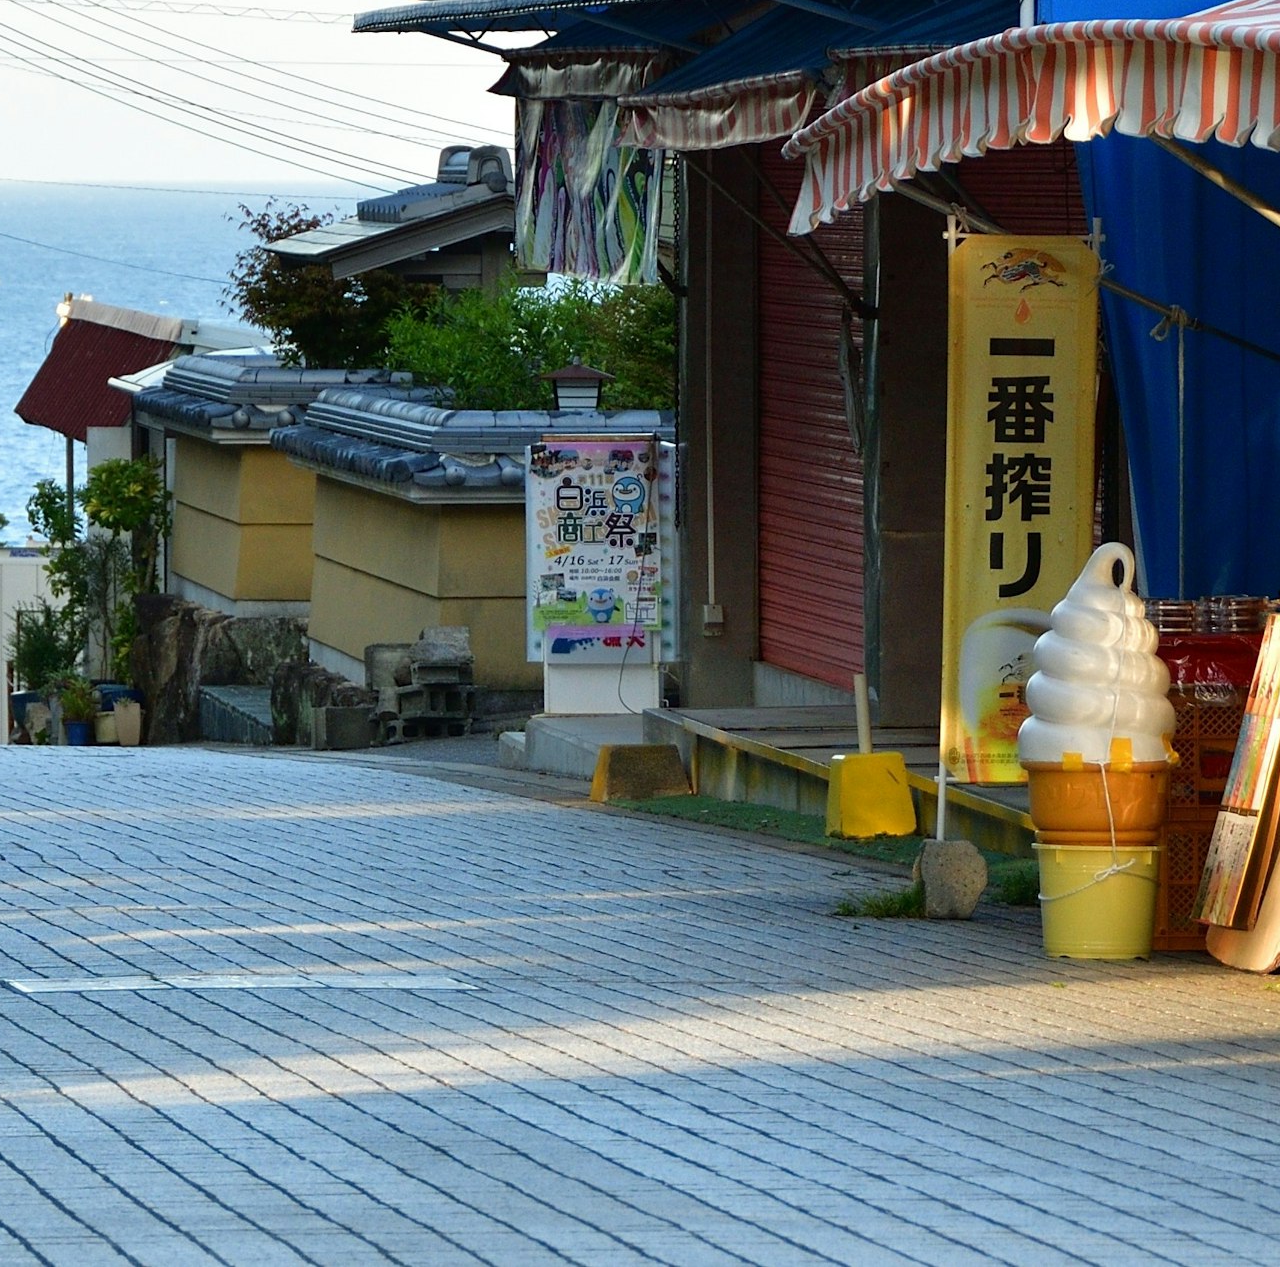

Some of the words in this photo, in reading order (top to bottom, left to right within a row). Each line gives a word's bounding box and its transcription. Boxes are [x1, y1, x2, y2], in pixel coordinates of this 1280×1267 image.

[984, 336, 1056, 598] 一番搾り
[556, 476, 608, 516] 白浜
[557, 511, 637, 548] 商工祭
[554, 555, 585, 567] 4/16
[608, 555, 624, 566] 17
